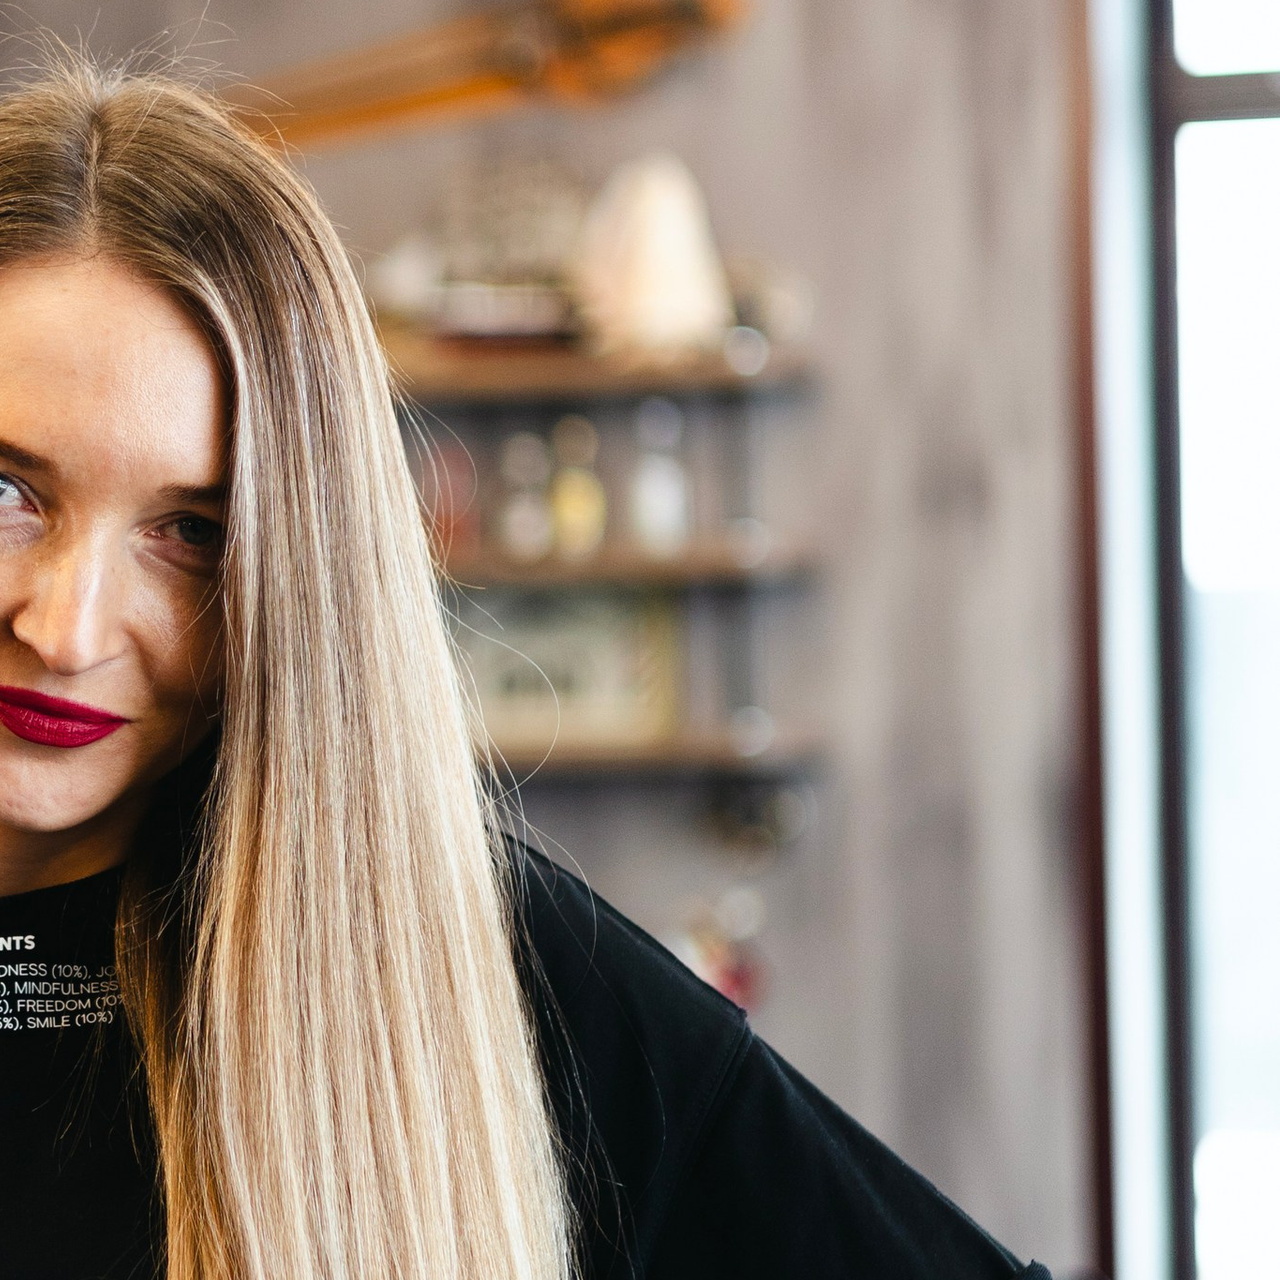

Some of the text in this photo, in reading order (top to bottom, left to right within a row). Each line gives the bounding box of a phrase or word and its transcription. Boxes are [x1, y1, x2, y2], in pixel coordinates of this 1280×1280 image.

[51, 964, 91, 980] (10%),
[96, 965, 117, 978] JO
[14, 980, 119, 995] MINDFULNESS
[17, 998, 91, 1013] FREEDOM
[26, 1015, 71, 1029] SMILE
[75, 1011, 114, 1027] (10%)
